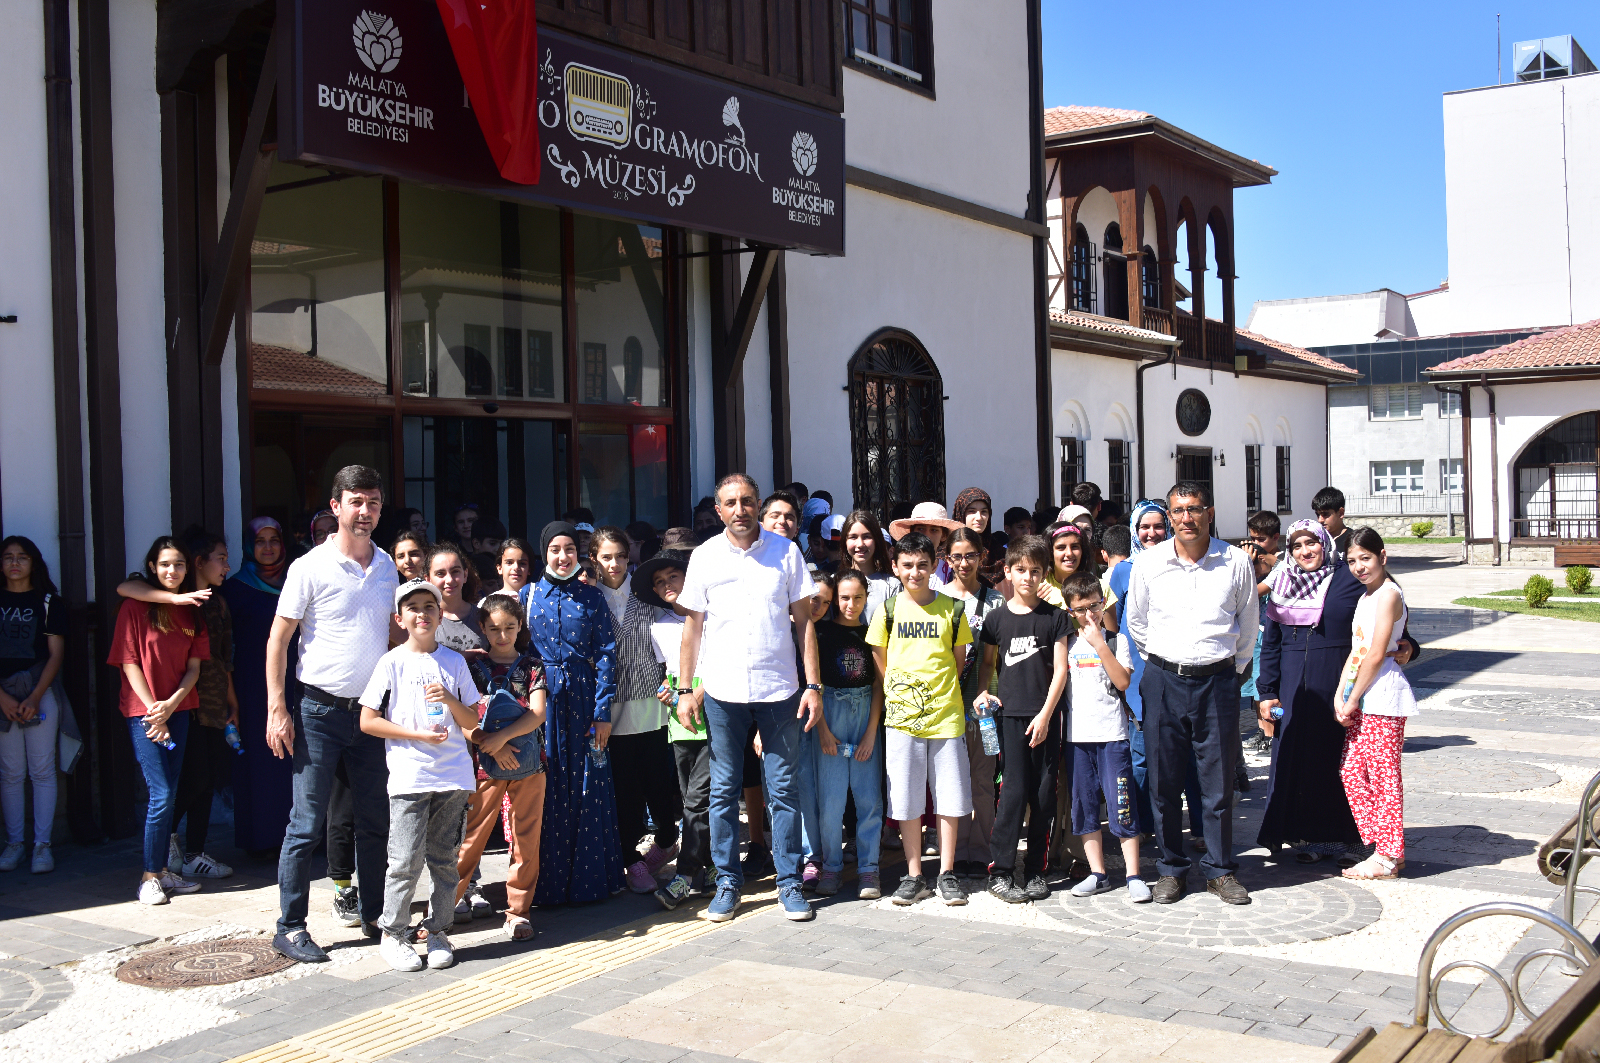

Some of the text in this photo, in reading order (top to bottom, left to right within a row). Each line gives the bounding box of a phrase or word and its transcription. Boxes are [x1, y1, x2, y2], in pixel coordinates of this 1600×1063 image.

[348, 70, 408, 98] MALATYA
[635, 123, 764, 183] GRAMOFON
[581, 150, 668, 197] MÜZESİ
[788, 176, 821, 194] MALATYA
[897, 621, 940, 638] MARVEL
[1009, 635, 1037, 654] NIKE
